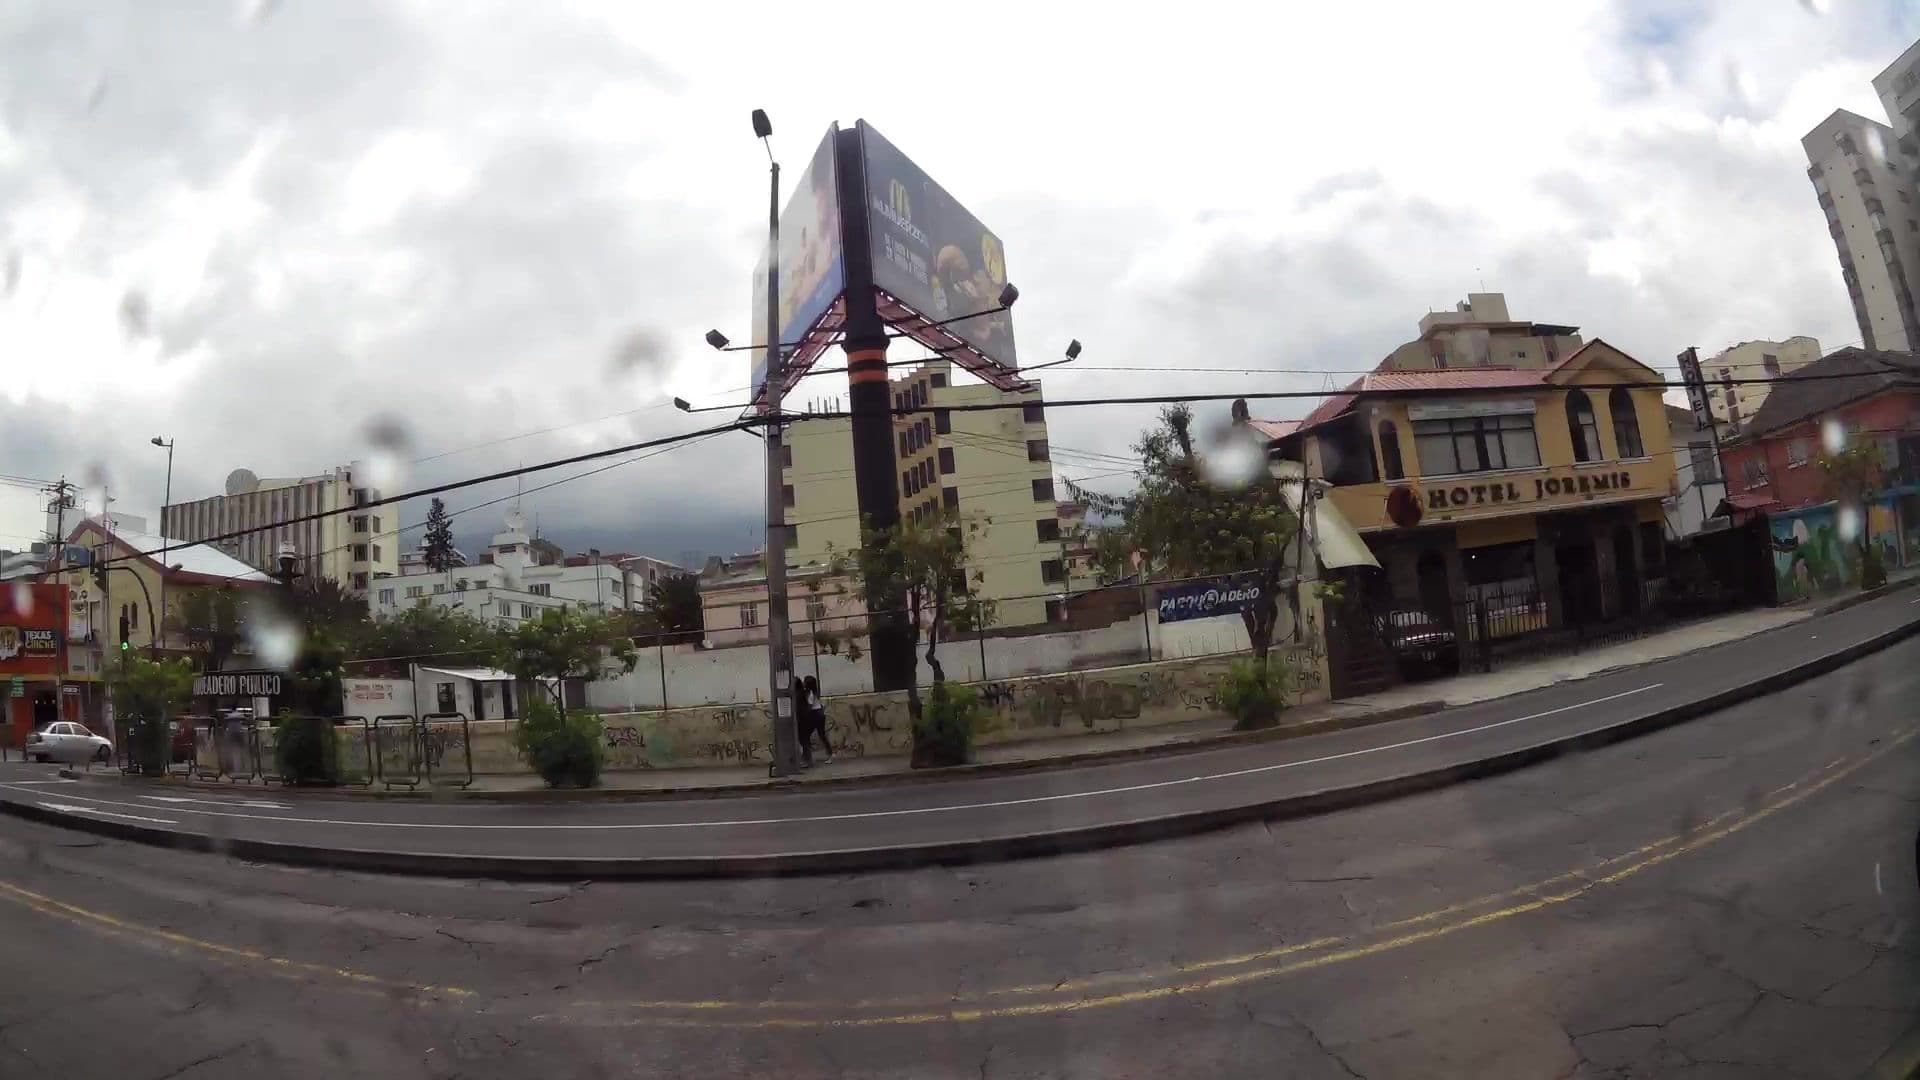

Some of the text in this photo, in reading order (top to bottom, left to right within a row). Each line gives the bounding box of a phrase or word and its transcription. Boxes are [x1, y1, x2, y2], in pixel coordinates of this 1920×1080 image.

[1428, 472, 1631, 508] HOTEL JOREMIS
[24, 630, 52, 640] TEXAS
